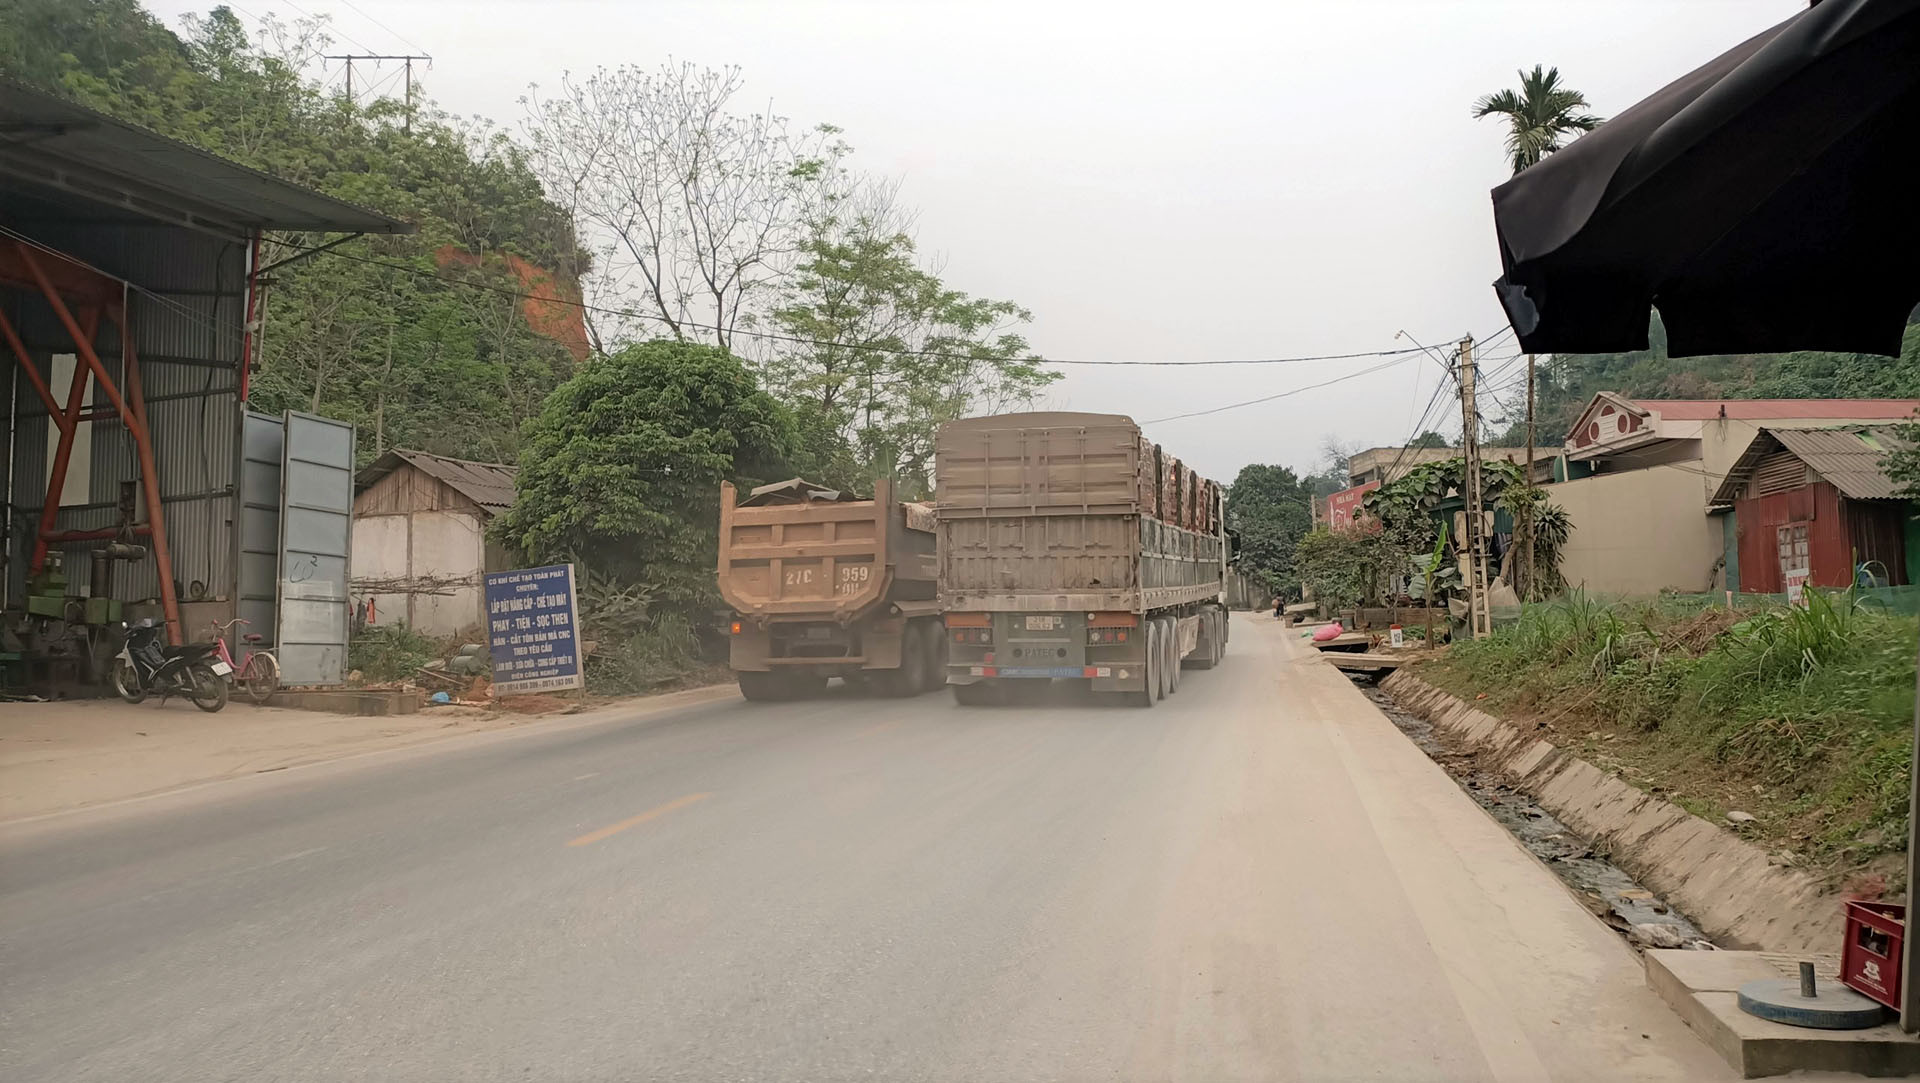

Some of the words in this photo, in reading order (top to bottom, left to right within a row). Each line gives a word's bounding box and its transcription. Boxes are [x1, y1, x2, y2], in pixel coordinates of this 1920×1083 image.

[509, 574, 520, 583] CHẾ
[550, 570, 564, 578] PHÁT
[492, 619, 509, 632] PHAY
[515, 615, 530, 631] TIỆN
[536, 615, 550, 629] SỌC
[551, 613, 568, 626] THEN
[513, 647, 528, 656] THEO
